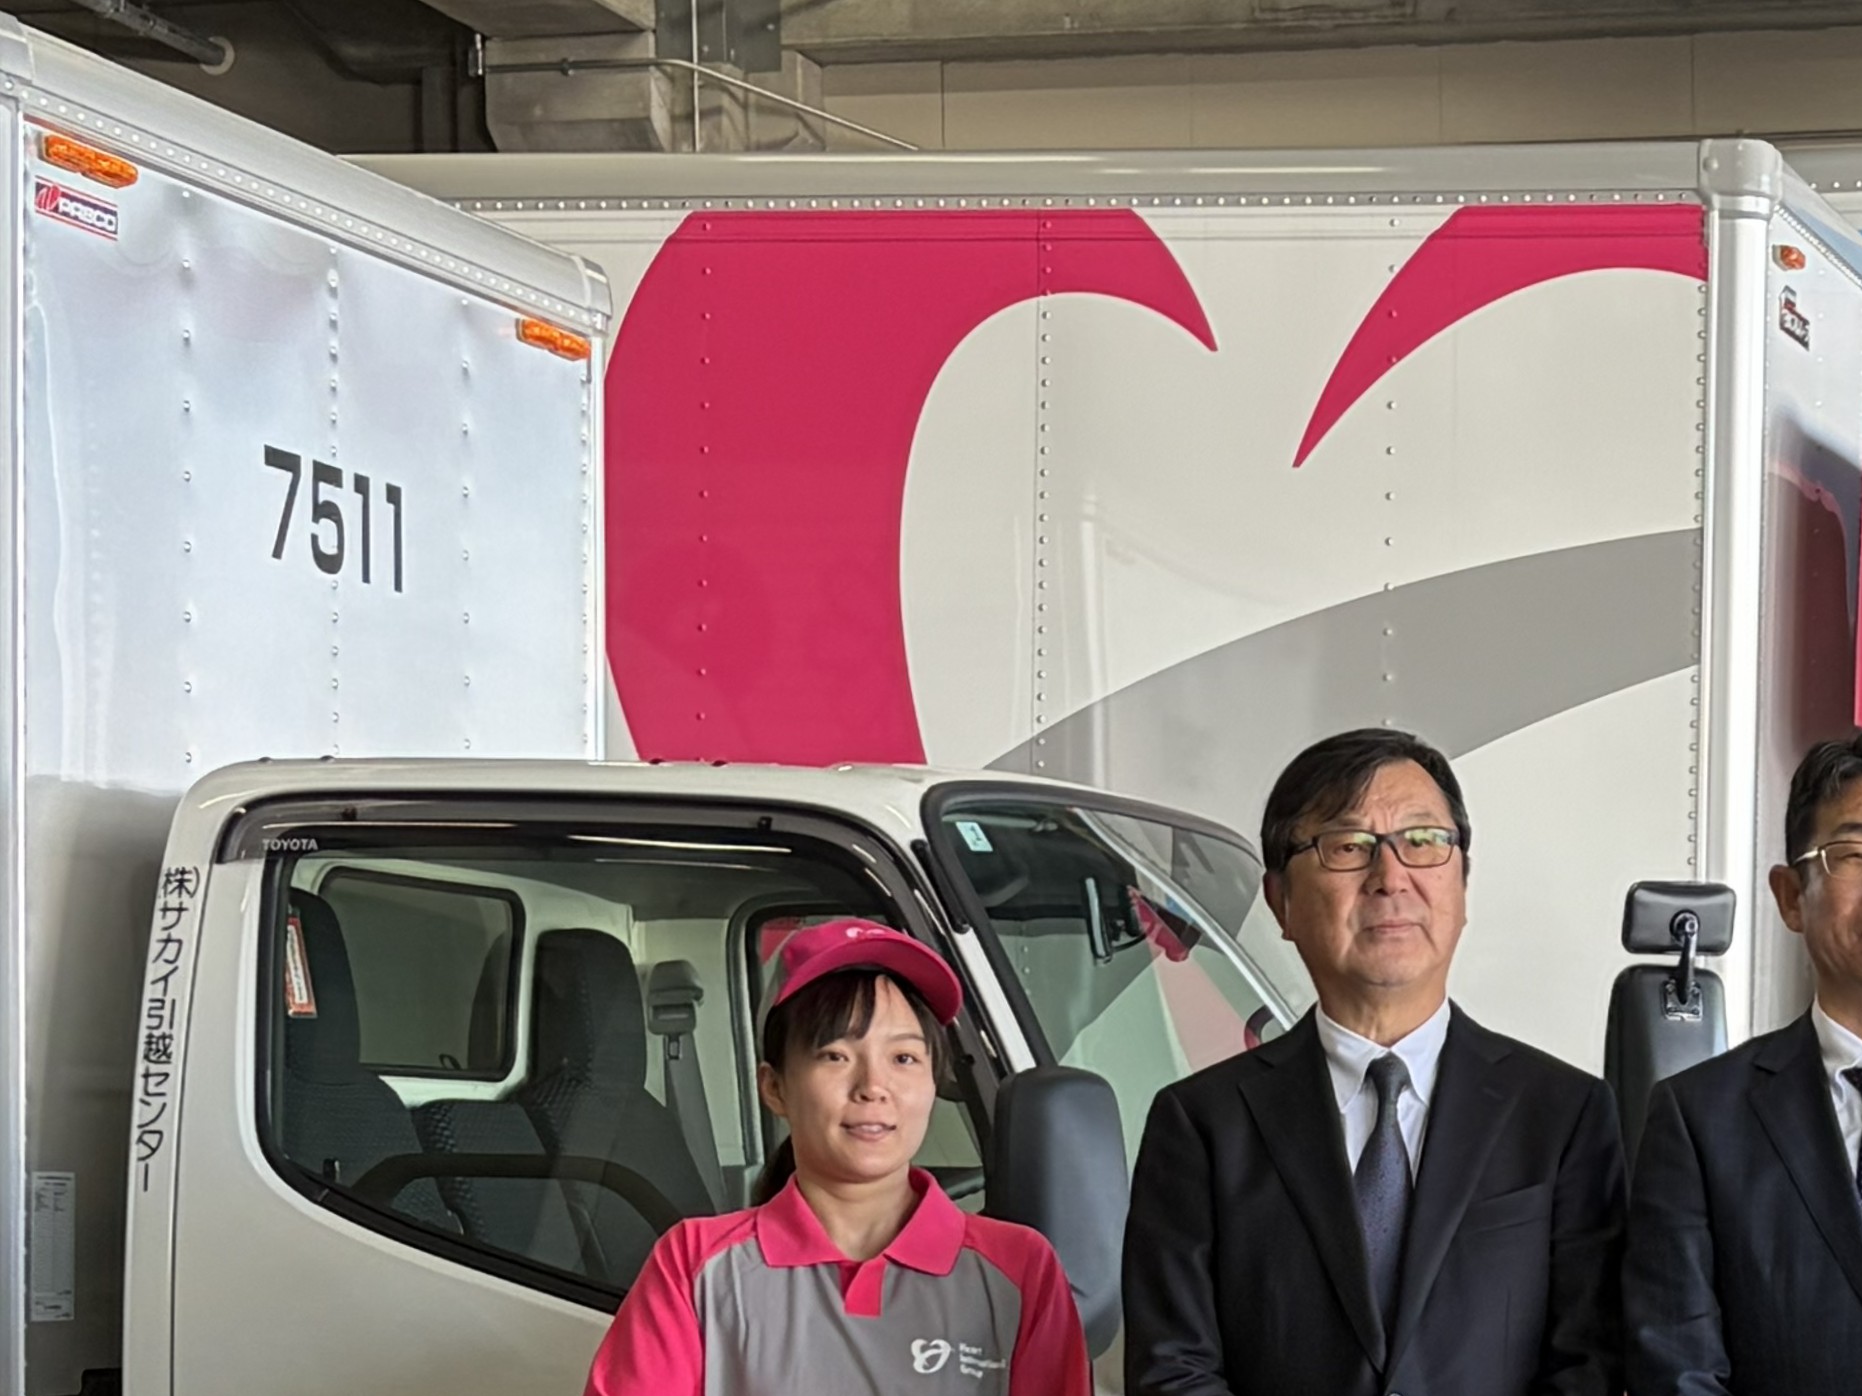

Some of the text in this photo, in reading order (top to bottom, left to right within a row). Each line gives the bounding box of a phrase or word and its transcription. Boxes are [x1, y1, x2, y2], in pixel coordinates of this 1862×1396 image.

[263, 443, 403, 594] 7511
[262, 837, 319, 851] TOYOTA
[133, 864, 201, 1193] 株)サカイ引越センター
